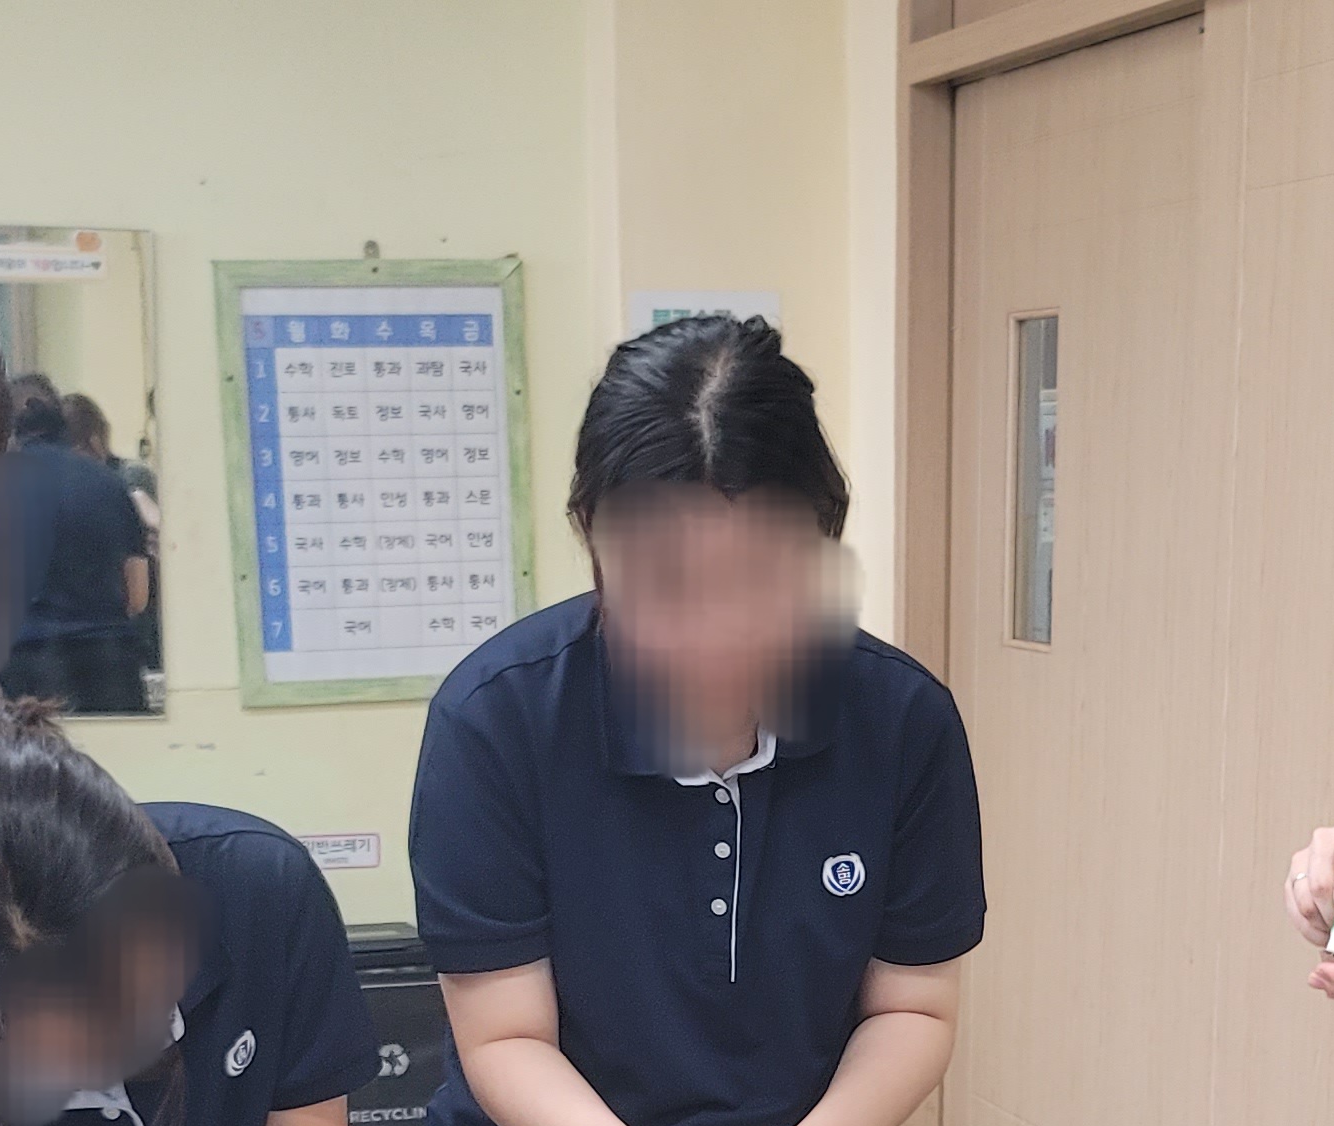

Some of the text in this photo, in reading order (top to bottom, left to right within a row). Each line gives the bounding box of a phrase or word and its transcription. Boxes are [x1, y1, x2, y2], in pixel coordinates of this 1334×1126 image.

[287, 320, 306, 343] 월
[330, 321, 351, 341] 화
[375, 321, 394, 341] 수
[420, 320, 438, 342] 목
[462, 321, 481, 342] 금
[255, 361, 266, 379] 1
[284, 361, 314, 378] 수학
[329, 361, 358, 378] 진로
[415, 360, 445, 377] 과탐
[459, 360, 487, 376] 국사
[258, 406, 270, 423] 2
[287, 405, 316, 422] 통사
[375, 405, 404, 422] 정보
[418, 404, 447, 420] 국사
[461, 403, 490, 420] 영어
[259, 447, 491, 467] 3 영어 정보 수학 영어 정보
[263, 493, 275, 509] 4
[292, 493, 322, 509] 통과
[336, 492, 365, 509] 통사
[380, 492, 408, 508] 인성
[422, 491, 450, 507] 통과
[267, 536, 279, 553] 5
[294, 536, 324, 551] 국사
[339, 535, 367, 551] 수학
[425, 533, 453, 549] 국어
[467, 531, 494, 548] 인성
[268, 579, 281, 597] 6
[297, 579, 327, 595] 국어
[341, 578, 369, 595] 통과
[427, 575, 454, 592] 통사
[469, 573, 496, 590] 통사
[271, 615, 498, 638] 7 국어 수학 국어
[349, 1106, 428, 1124] RECYCLIN
